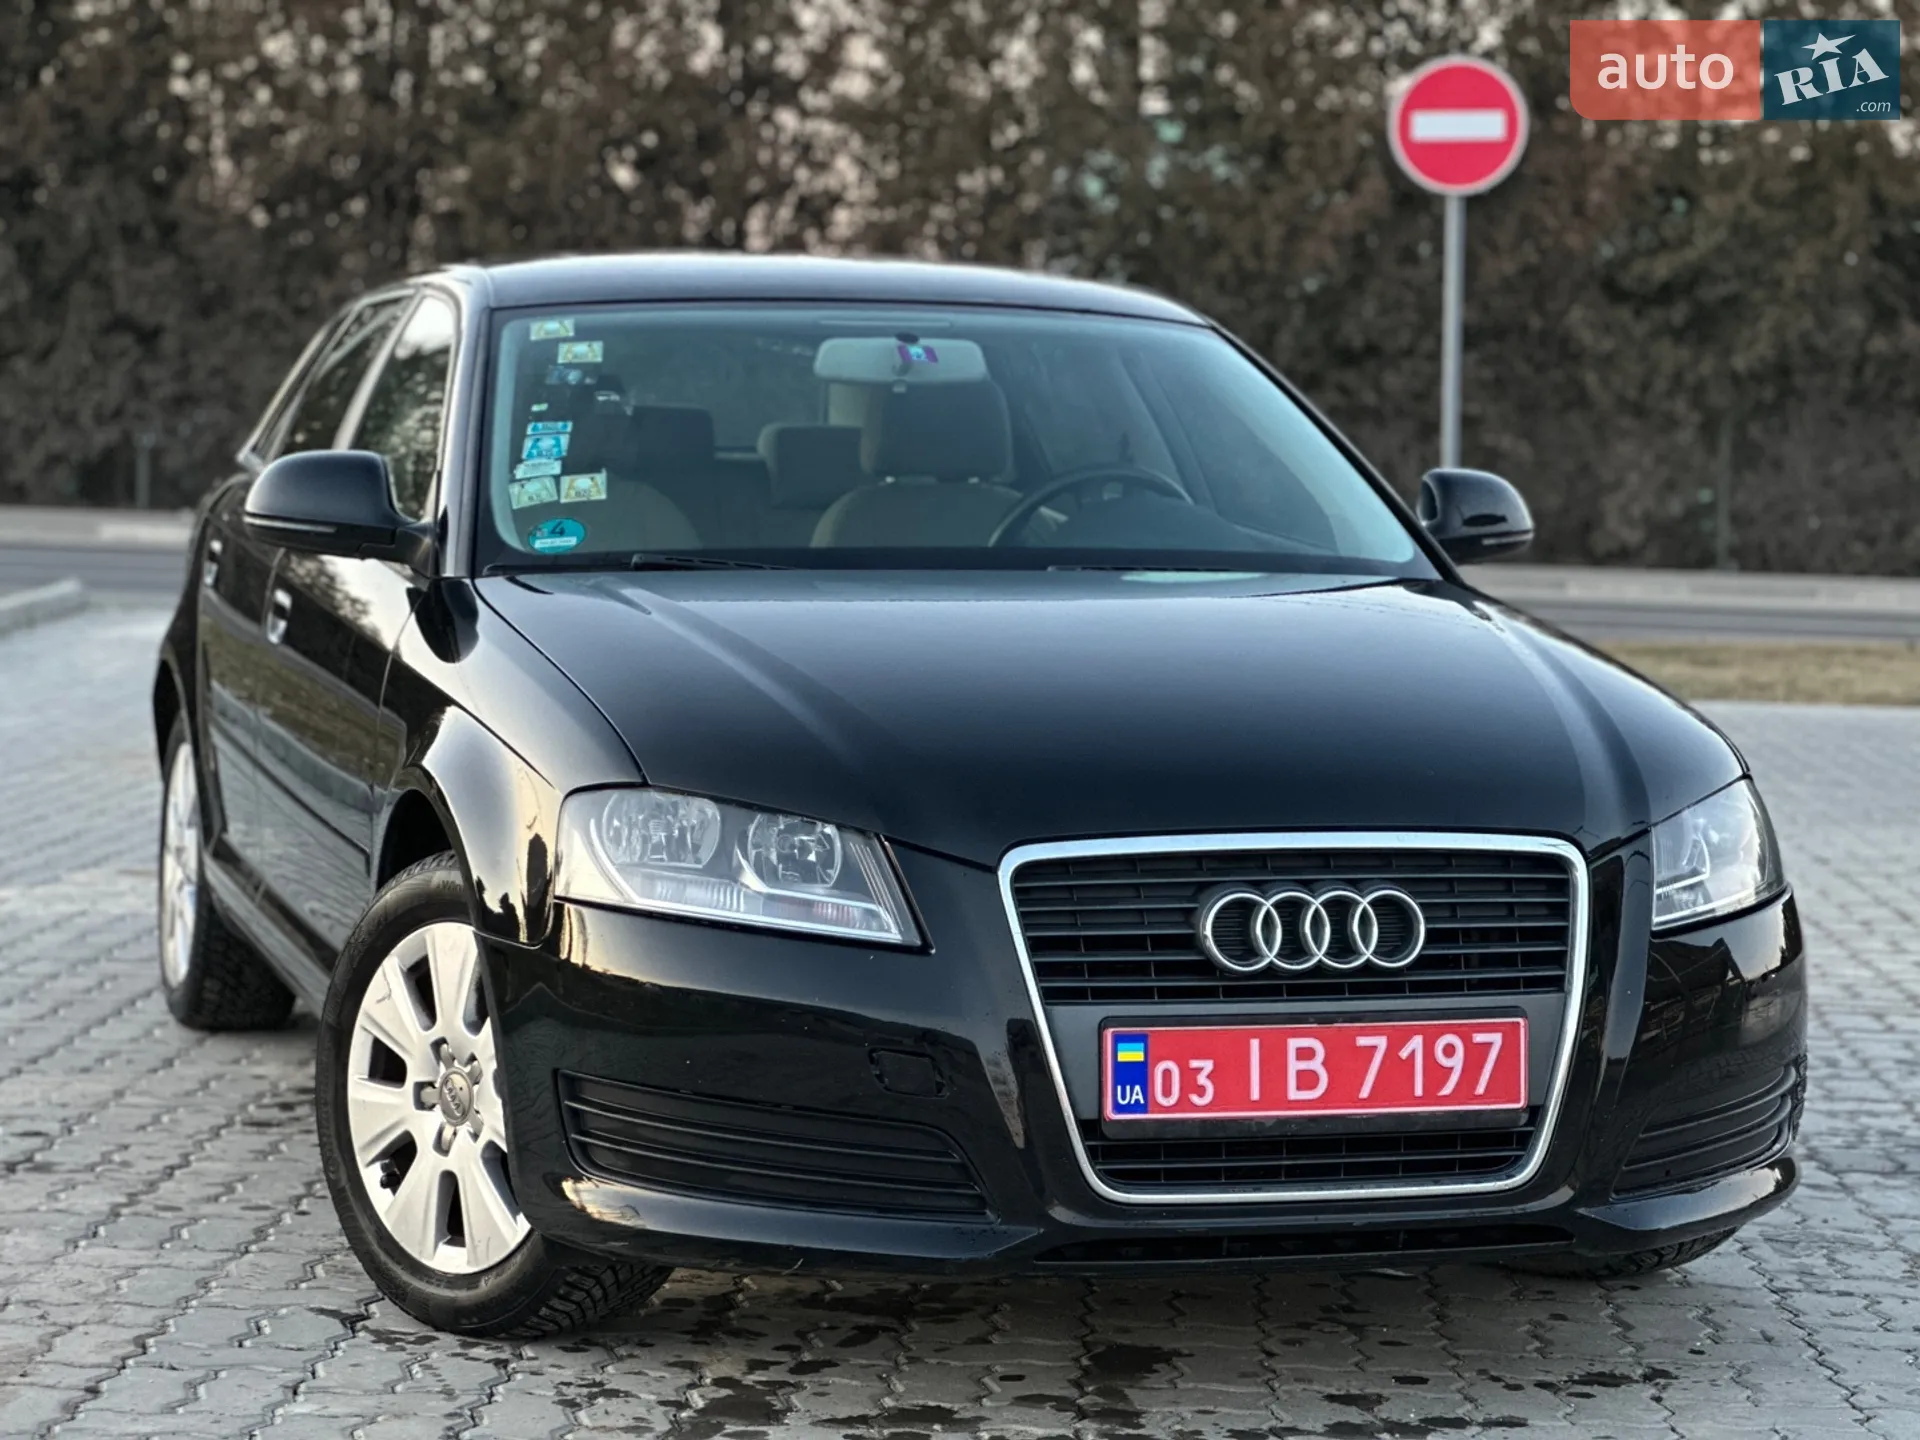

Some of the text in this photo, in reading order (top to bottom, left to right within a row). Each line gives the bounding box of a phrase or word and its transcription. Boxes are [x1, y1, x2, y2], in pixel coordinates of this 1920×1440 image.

[549, 520, 566, 536] 4
[1153, 1059, 1216, 1108] 03
[1355, 1032, 1504, 1099] 7197
[1116, 1084, 1145, 1106] UA
